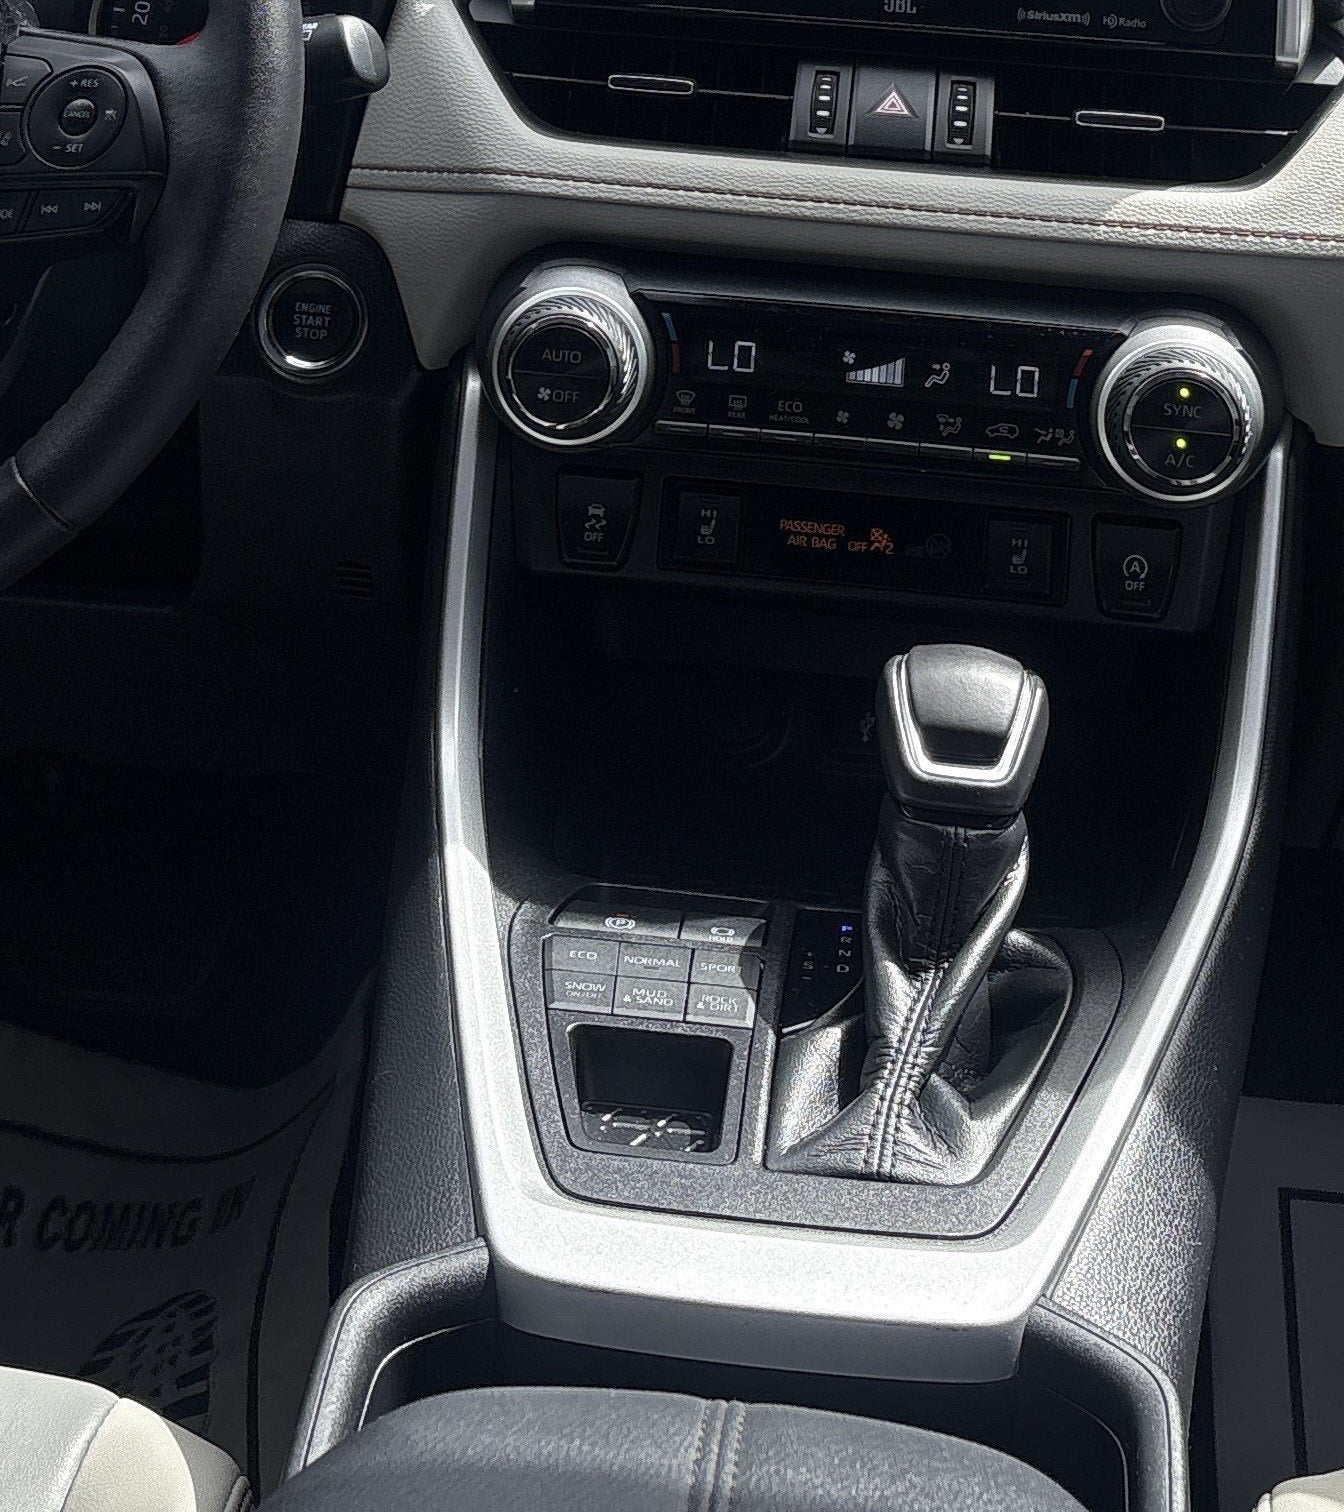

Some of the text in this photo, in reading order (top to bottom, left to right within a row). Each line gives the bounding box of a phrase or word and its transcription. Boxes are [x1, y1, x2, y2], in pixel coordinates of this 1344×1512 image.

[131, 0, 151, 26] 20
[1118, 17, 1148, 29] Radio
[78, 77, 100, 89] RES
[64, 143, 85, 155] SET
[294, 302, 333, 315] ENGINE
[293, 314, 332, 328] START
[293, 326, 329, 341] STOP
[541, 348, 582, 364] AUTO
[707, 339, 757, 374] LO
[989, 363, 1040, 399] LO
[552, 389, 582, 404] OFF
[778, 399, 803, 414] ECO
[1162, 402, 1203, 419] SYNC
[768, 413, 810, 424] HEAT/COOL
[1164, 451, 1197, 469] A/C
[700, 508, 718, 518] HI
[778, 518, 846, 538] PASSENGER
[583, 532, 604, 543] OFF
[697, 536, 716, 546] LO
[1011, 538, 1029, 549] HI
[786, 535, 808, 550] AIR
[811, 535, 838, 551] BAG
[847, 540, 872, 554] OFF
[1009, 564, 1029, 575] LO
[1124, 579, 1146, 591] OFF
[569, 950, 598, 961] ECO
[838, 949, 853, 958] N
[623, 954, 682, 969] NORMAL
[836, 964, 850, 974] D
[564, 980, 607, 992] SNOW
[632, 987, 668, 999] MUD
[701, 993, 738, 1006] ROCK
[635, 995, 674, 1007] SAND
[708, 1001, 740, 1014] DIRT
[35, 1191, 204, 1255] COMING
[206, 1178, 256, 1238] IN
